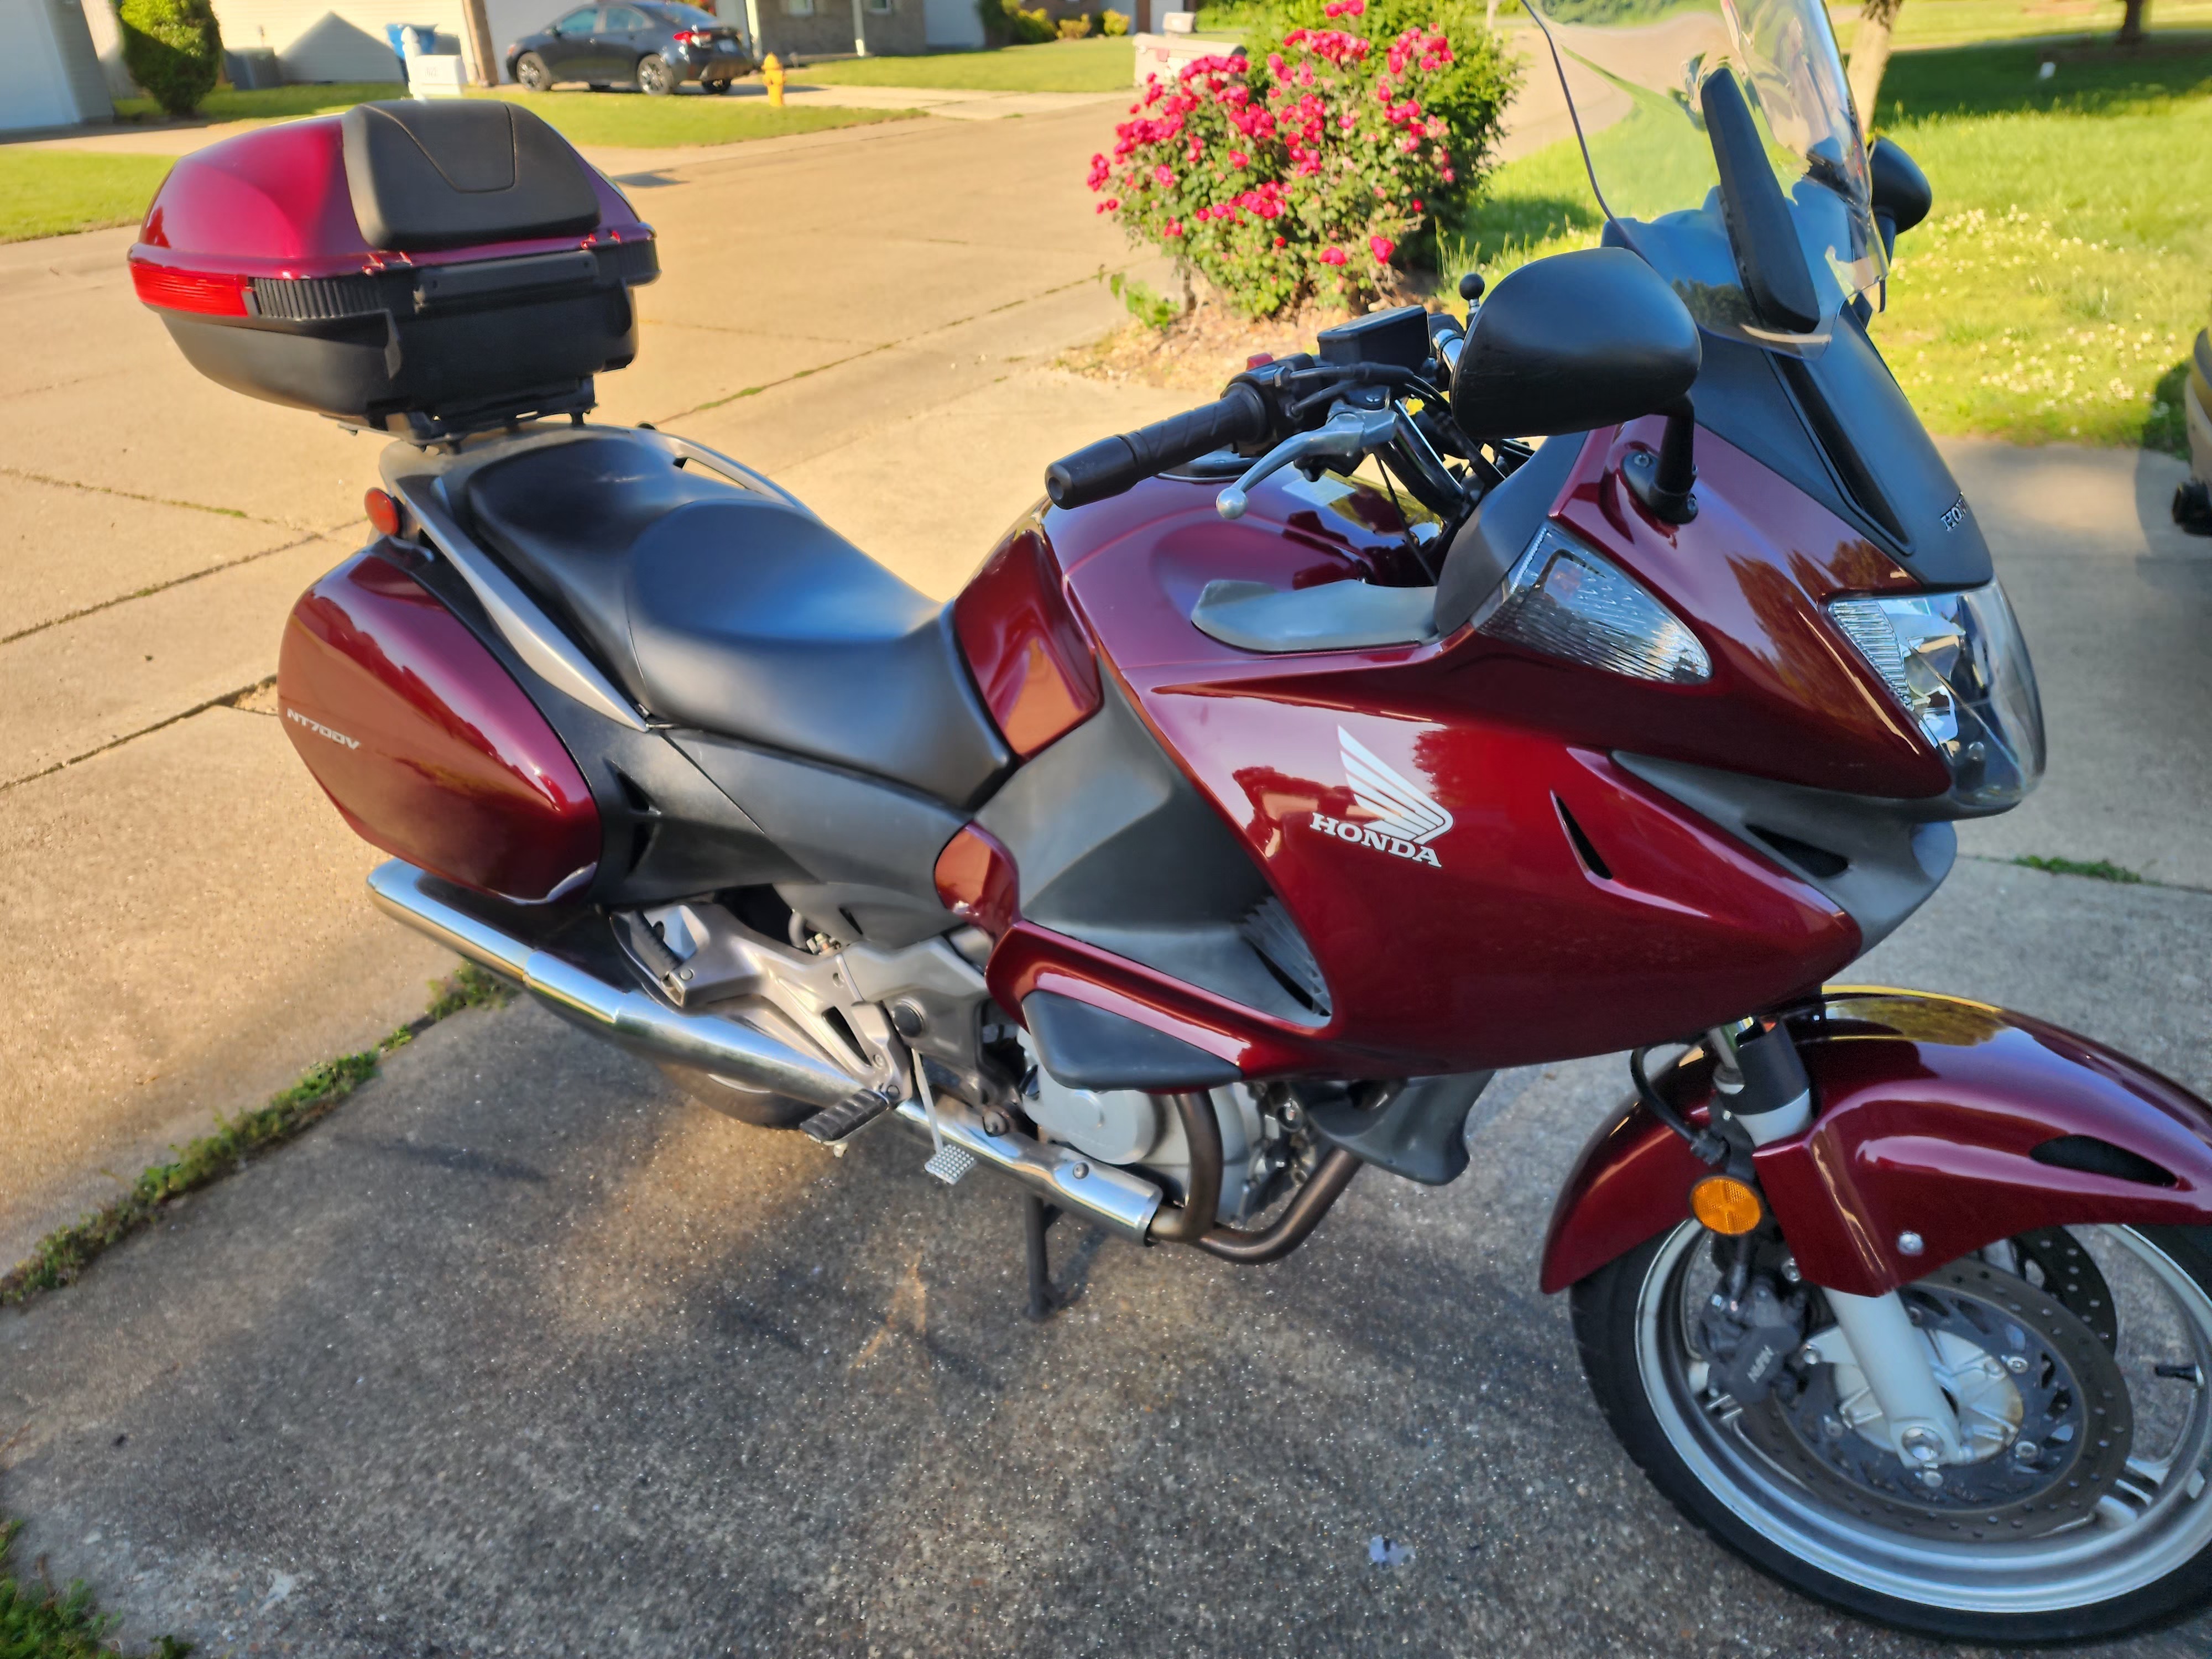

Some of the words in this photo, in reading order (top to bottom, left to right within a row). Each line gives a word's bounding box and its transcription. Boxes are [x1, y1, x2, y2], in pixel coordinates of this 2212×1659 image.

[1940, 490, 1967, 532] HON
[286, 707, 361, 750] NT700V
[1309, 812, 1442, 868] HONDA
